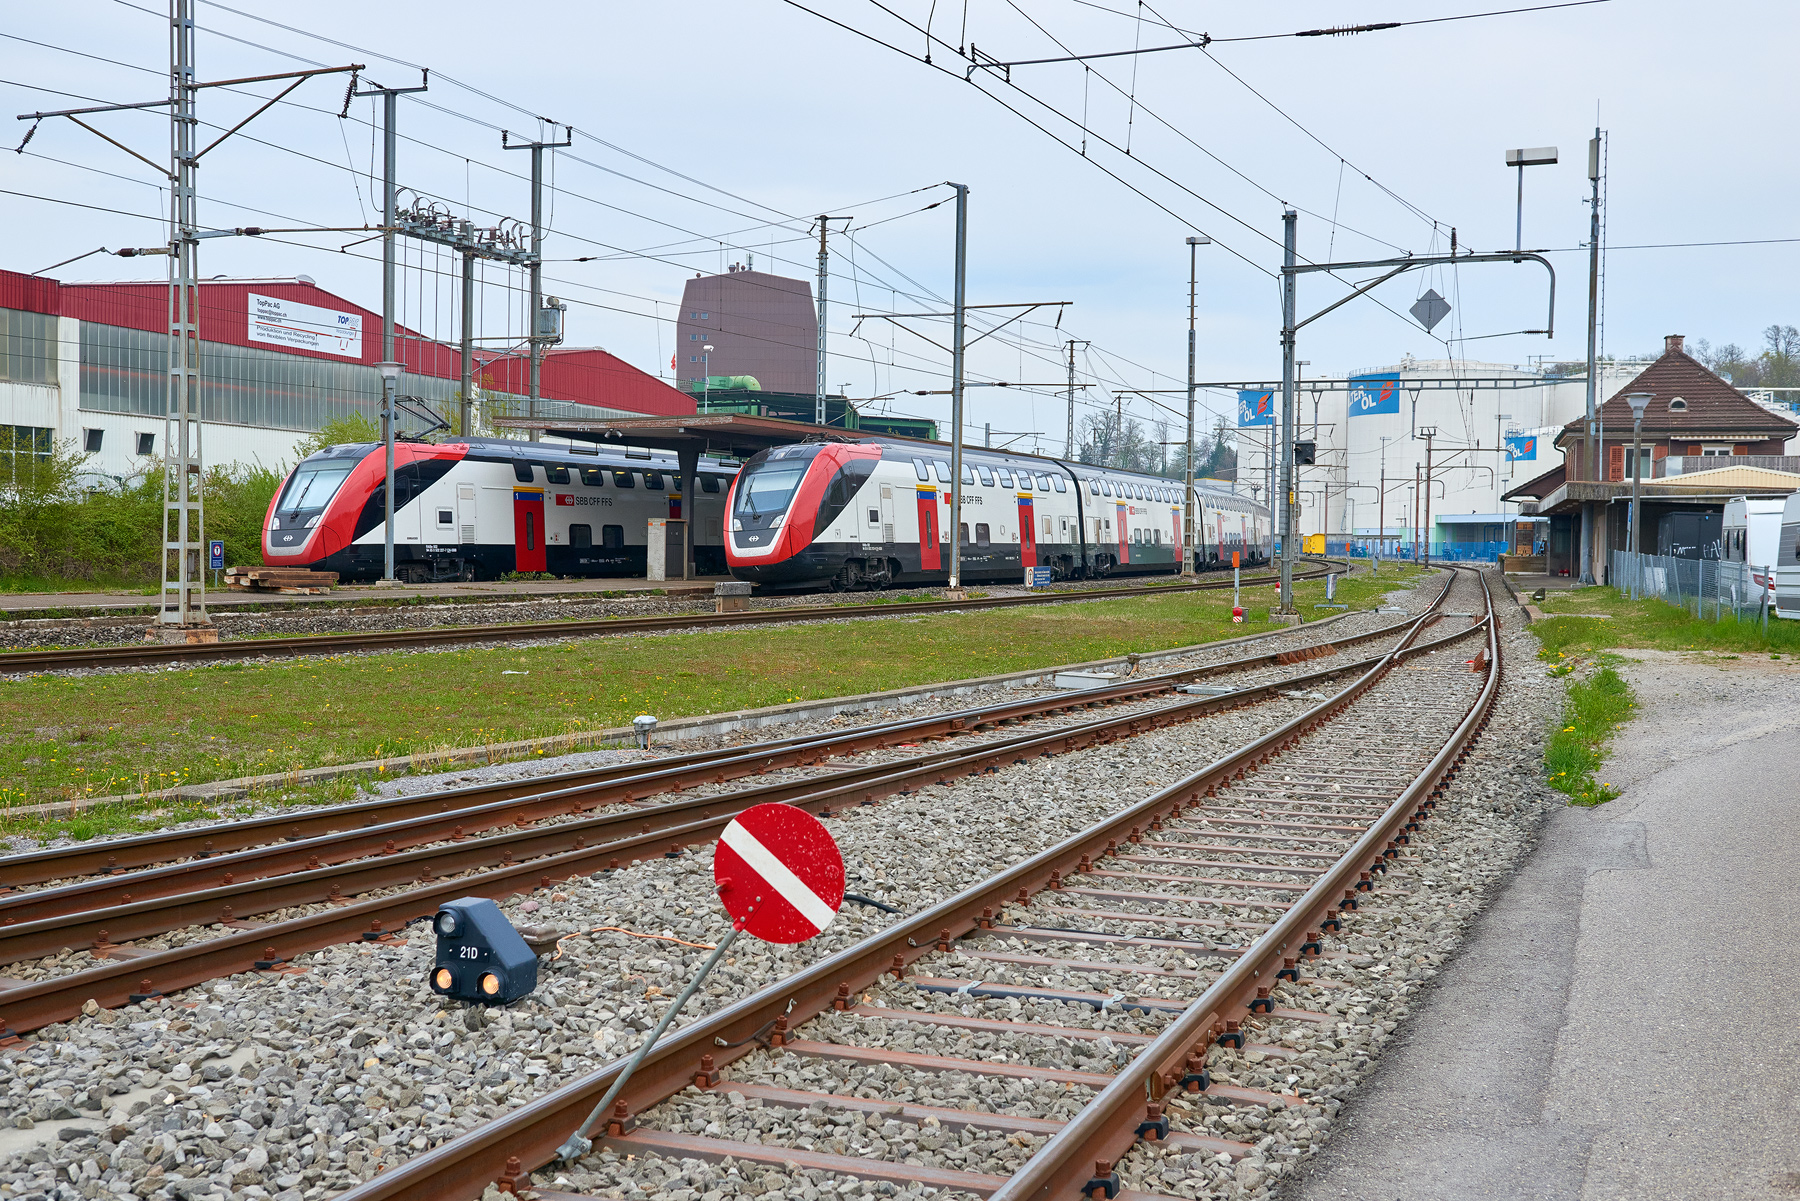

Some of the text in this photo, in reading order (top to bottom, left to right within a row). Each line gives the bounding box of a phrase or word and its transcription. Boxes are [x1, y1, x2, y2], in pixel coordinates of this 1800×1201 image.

[257, 299, 273, 308] TopPac
[256, 324, 282, 334] Produktion
[293, 331, 316, 341] Recycling
[267, 333, 287, 341] flexiblen
[287, 336, 320, 346] Verpackungen
[515, 492, 519, 500] 1
[575, 496, 613, 507] SBB CFF FFS
[966, 495, 975, 505] CFF
[975, 496, 983, 505] FFS
[460, 945, 478, 960] 21D
